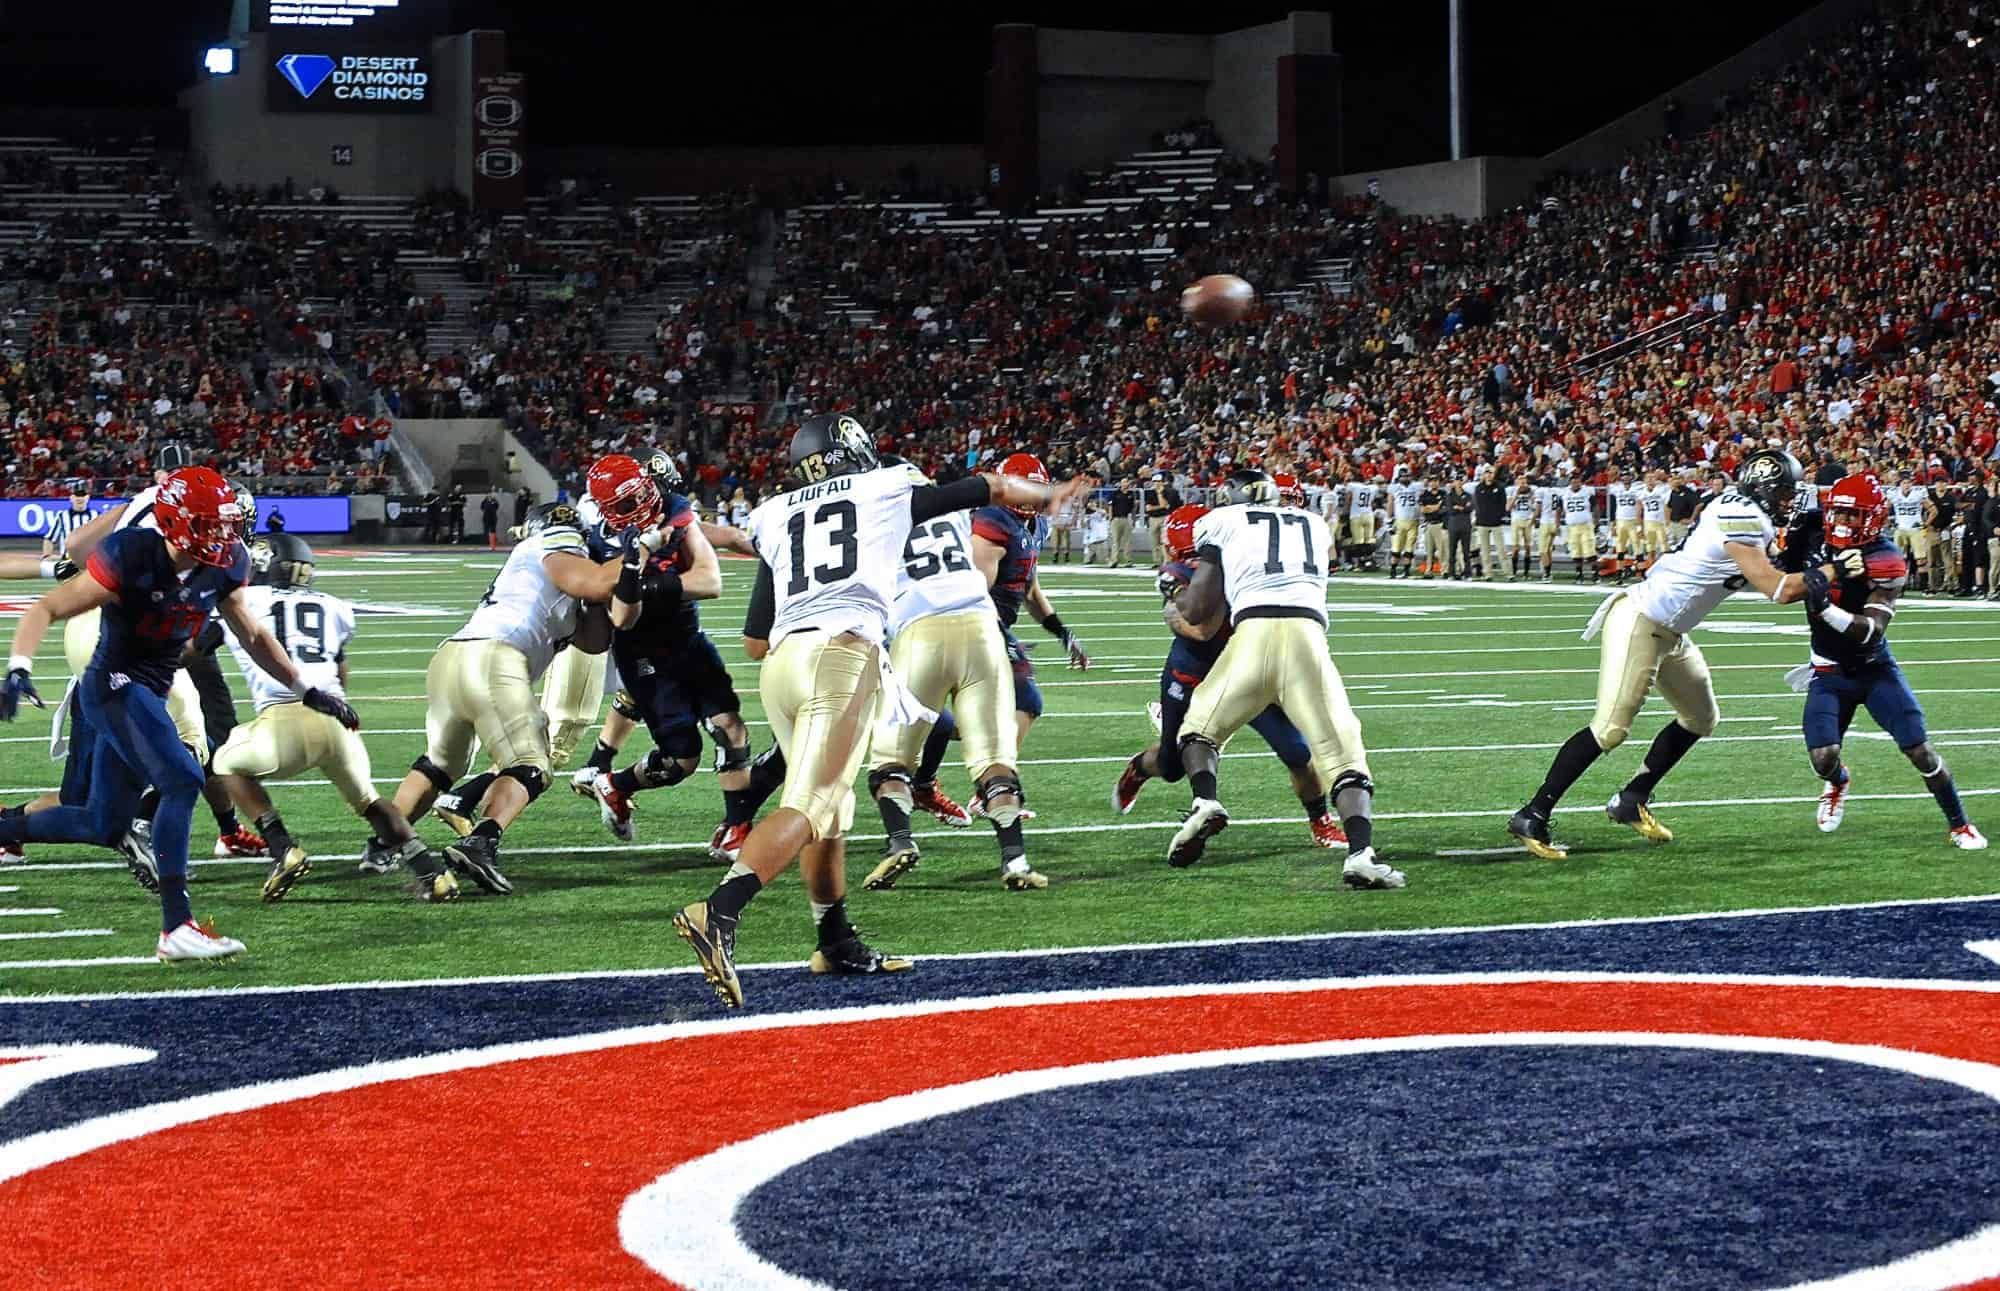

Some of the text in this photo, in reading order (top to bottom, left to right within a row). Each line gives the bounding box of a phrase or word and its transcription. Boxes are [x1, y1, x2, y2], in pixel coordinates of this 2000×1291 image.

[342, 56, 419, 71] DESERT
[332, 71, 428, 86] DIAMOND
[334, 86, 425, 101] CASINOS
[335, 149, 352, 163] 14
[800, 453, 828, 483] 13
[787, 478, 852, 506] LIUFAU
[787, 499, 858, 597] 13
[903, 521, 972, 581] 52
[1245, 510, 1319, 575] 77
[267, 600, 328, 663] 19
